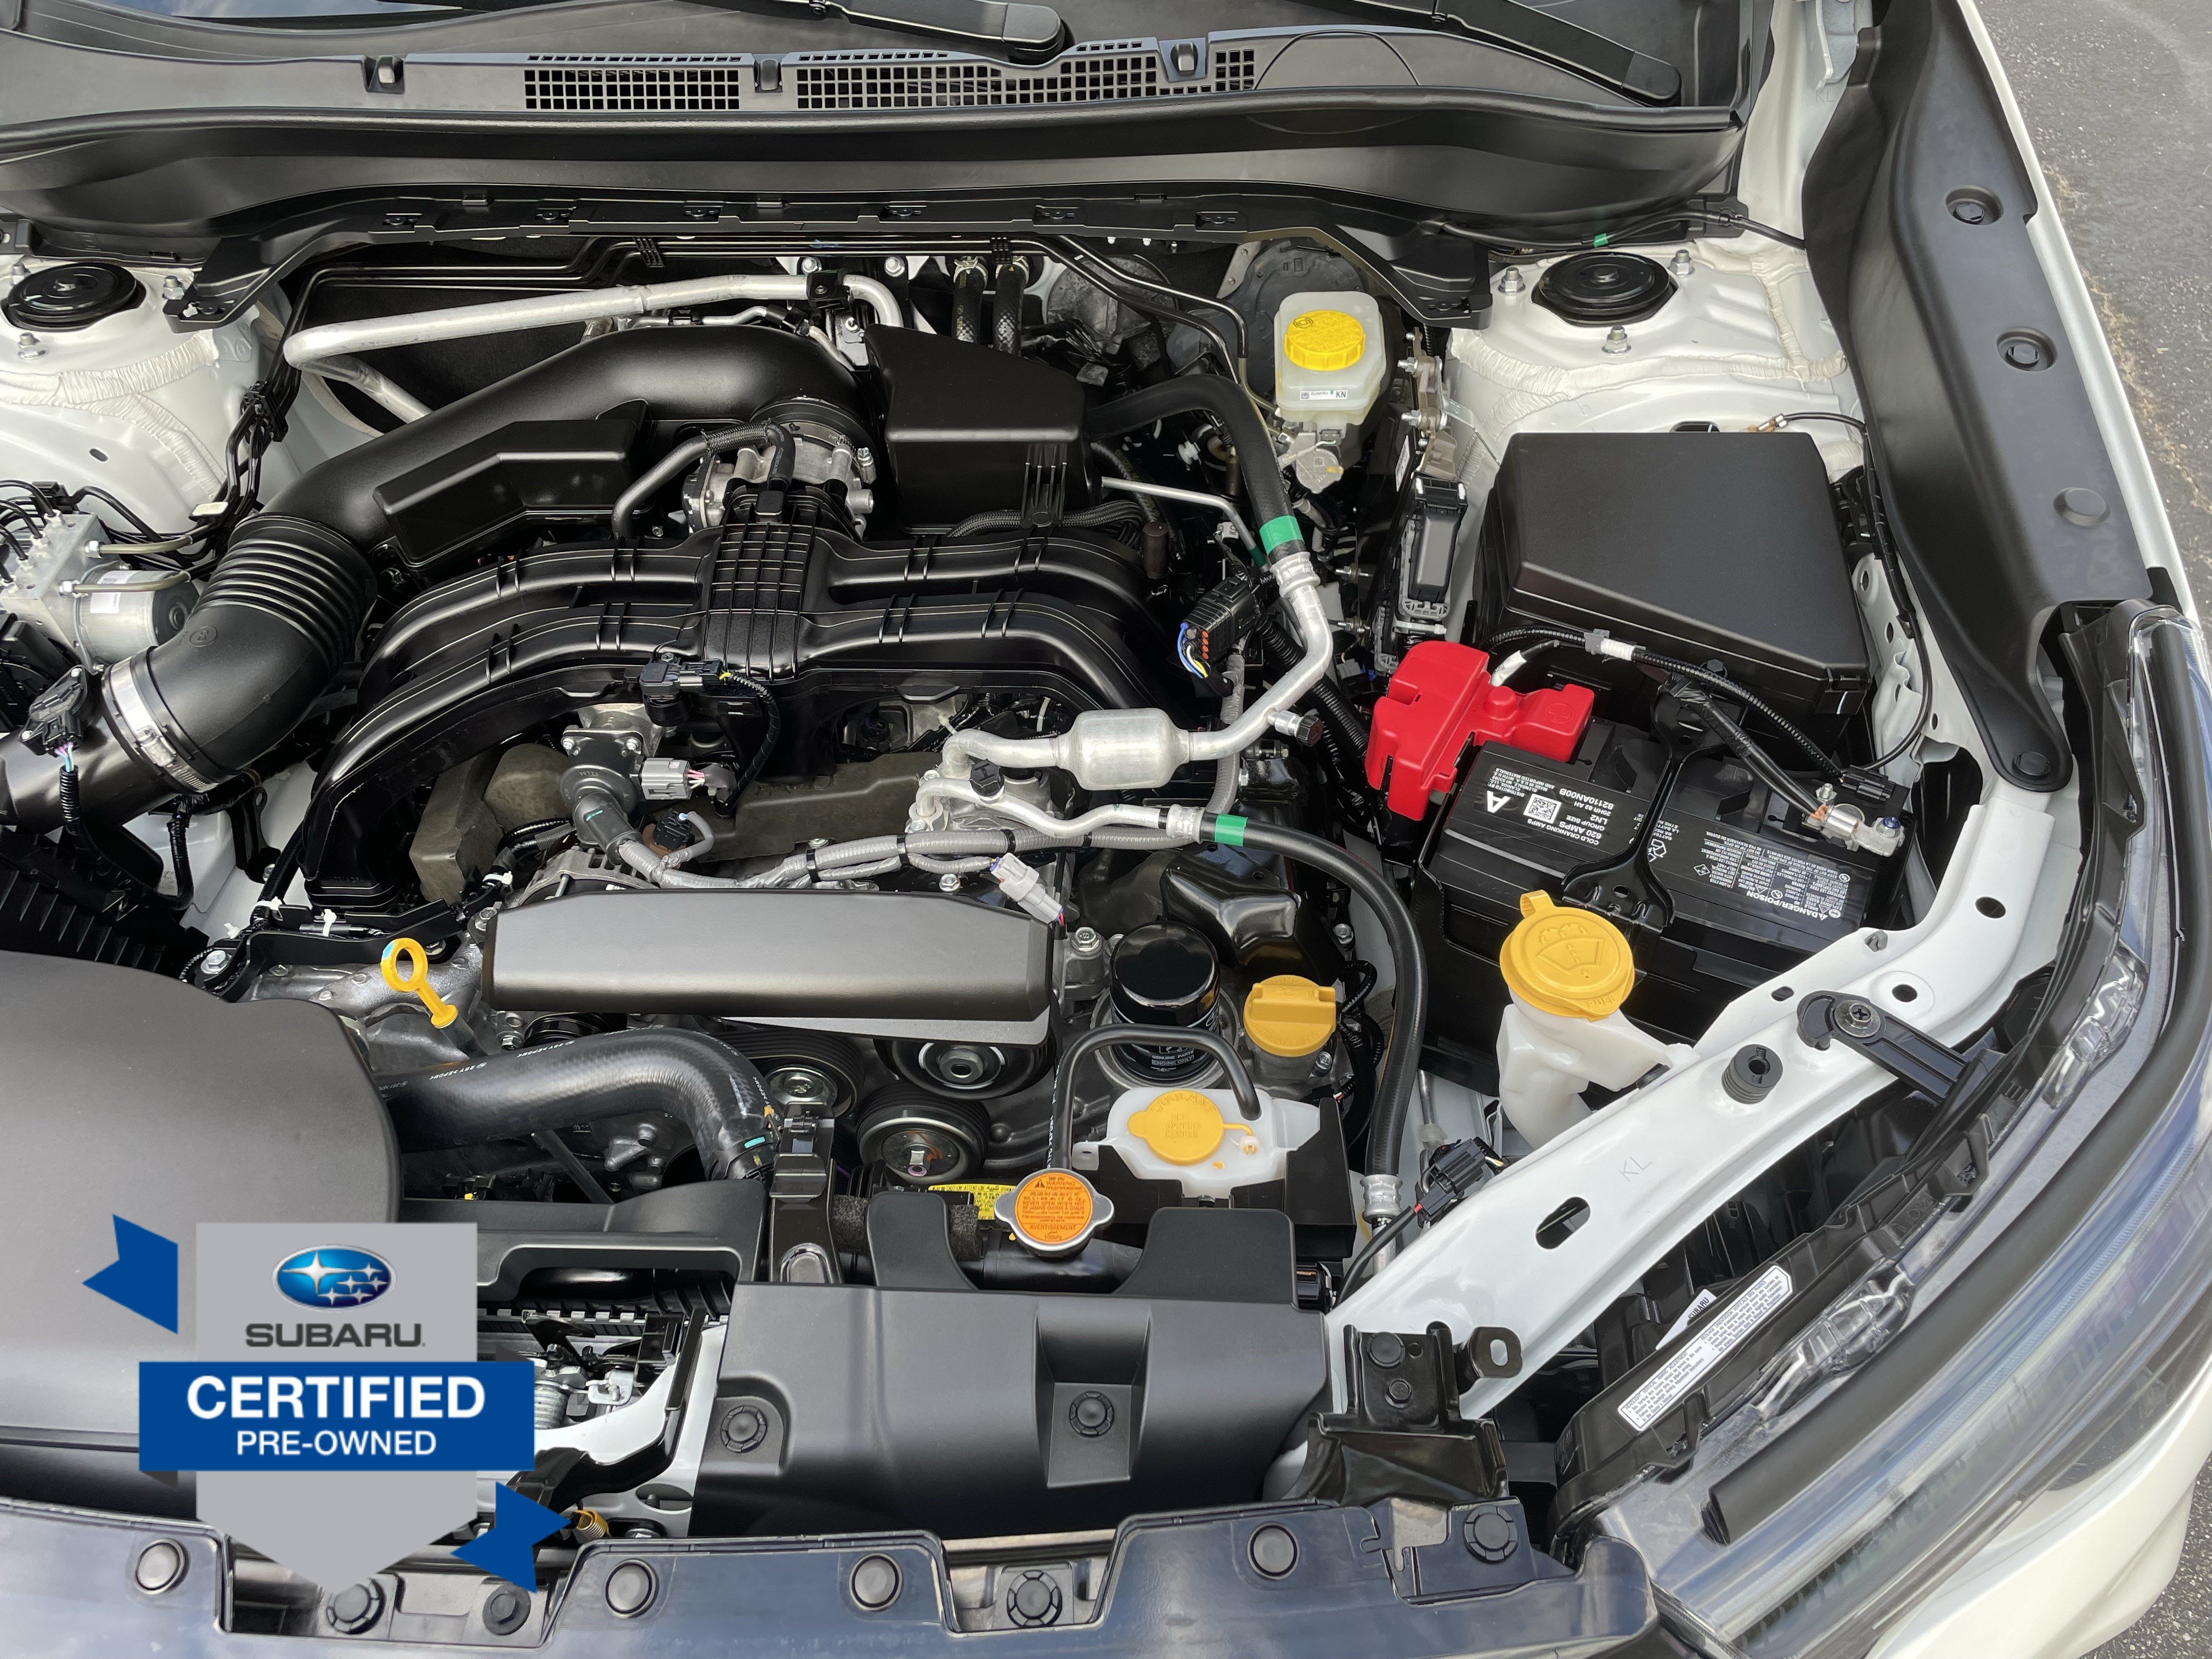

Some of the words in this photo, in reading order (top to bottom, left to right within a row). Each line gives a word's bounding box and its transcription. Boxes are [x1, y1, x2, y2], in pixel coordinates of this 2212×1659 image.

[1495, 767, 1521, 779] MATERIALS
[1521, 775, 1544, 786] IMPORTED
[1481, 789, 1511, 816] A
[1559, 787, 1614, 811] 82110AN00B
[1593, 806, 1611, 816] 20HR
[1526, 817, 1545, 828] AMPS
[1565, 814, 1581, 823] SIZE
[1589, 814, 1607, 825] LN2
[1546, 823, 1578, 839] CRANKING
[1558, 820, 1585, 834] AMPS
[1581, 819, 1605, 831] GROUP
[1580, 835, 1599, 845] COLD
[1585, 829, 1602, 839] 620
[1746, 889, 1818, 919] DANGER/POISON
[1586, 996, 1618, 1009] PULL
[1177, 1049, 1194, 1058] PARTS
[1177, 1054, 1193, 1064] ONLY
[1152, 1093, 1216, 1113] COOLANT
[1620, 1156, 1653, 1182] KL
